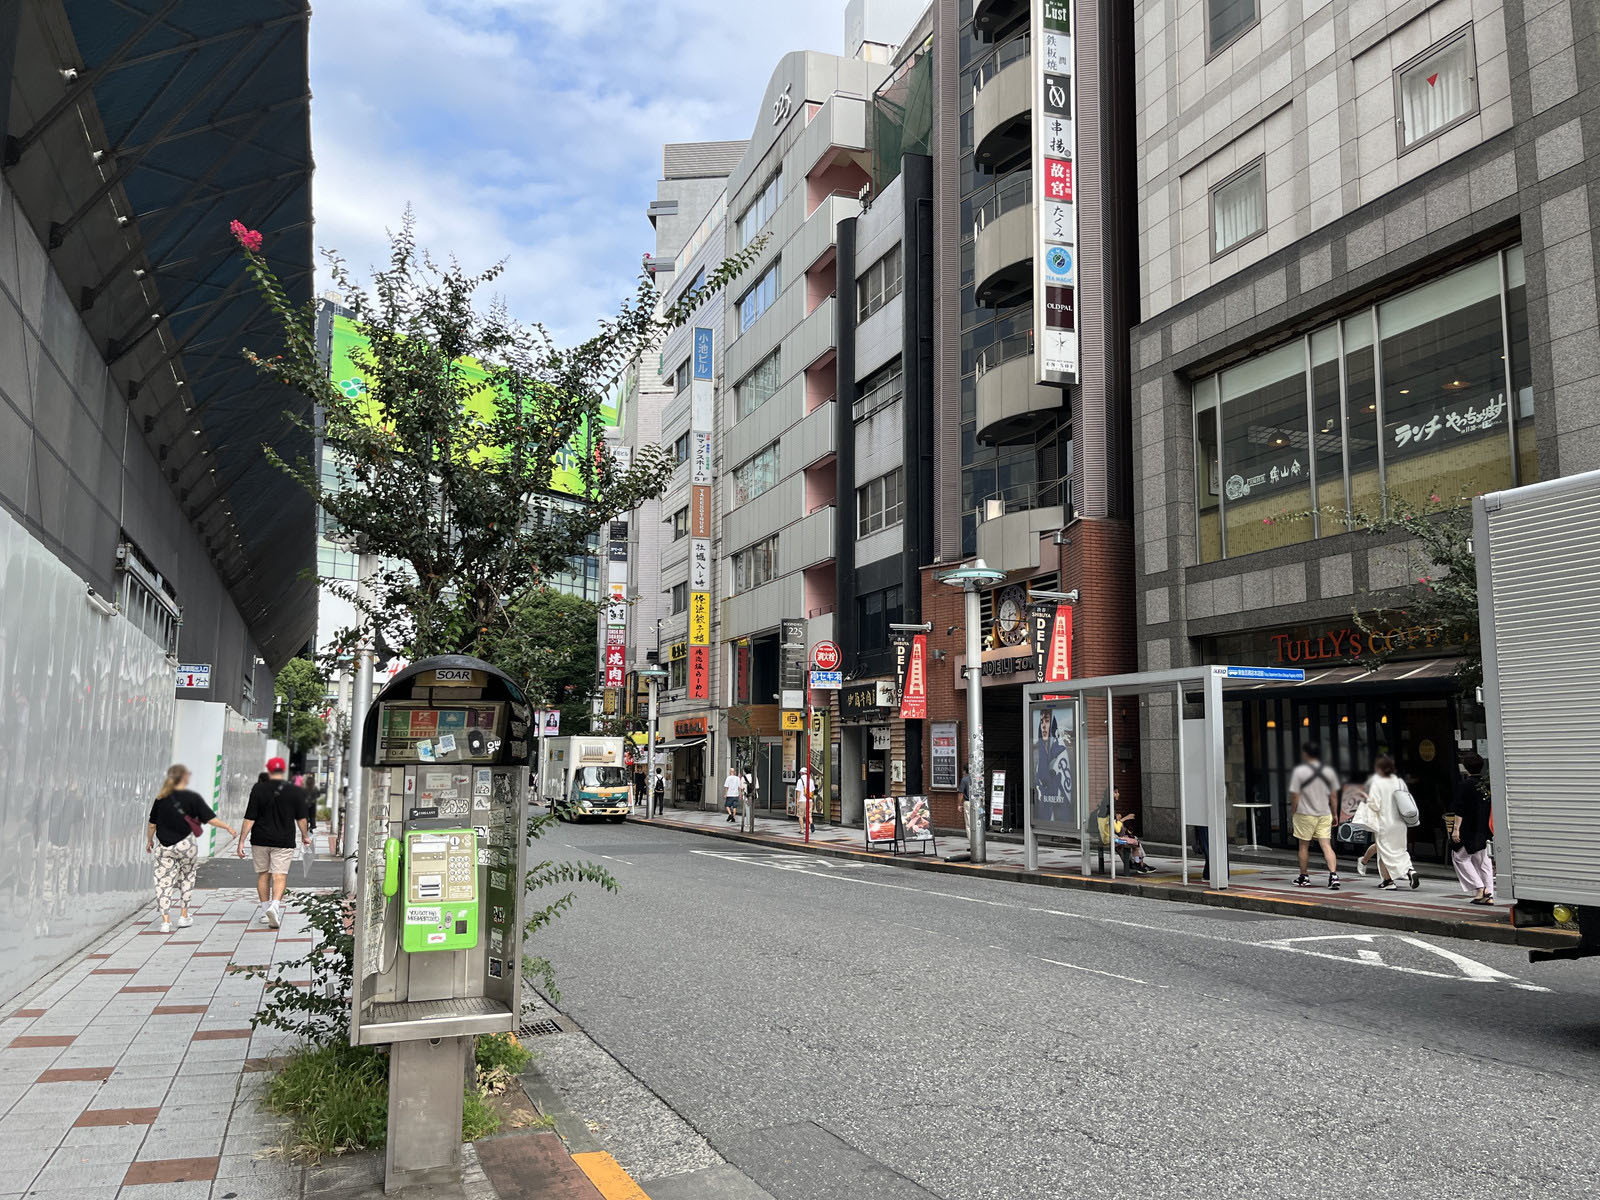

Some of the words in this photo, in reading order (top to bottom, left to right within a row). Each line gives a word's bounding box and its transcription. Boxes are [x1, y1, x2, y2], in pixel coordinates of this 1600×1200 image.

[1045, 3, 1067, 22] Lust
[1046, 35, 1058, 71] 鉄板焼
[1050, 119, 1066, 154] 串揚
[1050, 162, 1065, 196] 故宮
[1053, 205, 1065, 238] たくみ
[1056, 276, 1073, 284] MAGIC
[698, 333, 709, 374] 小池ビル
[1394, 414, 1443, 449] ランチ
[788, 627, 803, 638] 225
[1036, 618, 1046, 665] DELI
[1271, 628, 1363, 663] TULLY'S
[1368, 624, 1470, 655] COFF
[608, 652, 623, 681] 焼肉
[816, 651, 836, 662] 消火栓
[896, 646, 906, 683] DELI
[986, 656, 1013, 676] DELI
[186, 674, 194, 686] 1
[436, 670, 471, 680] SOAR
[1043, 794, 1065, 803] BURBERRY
